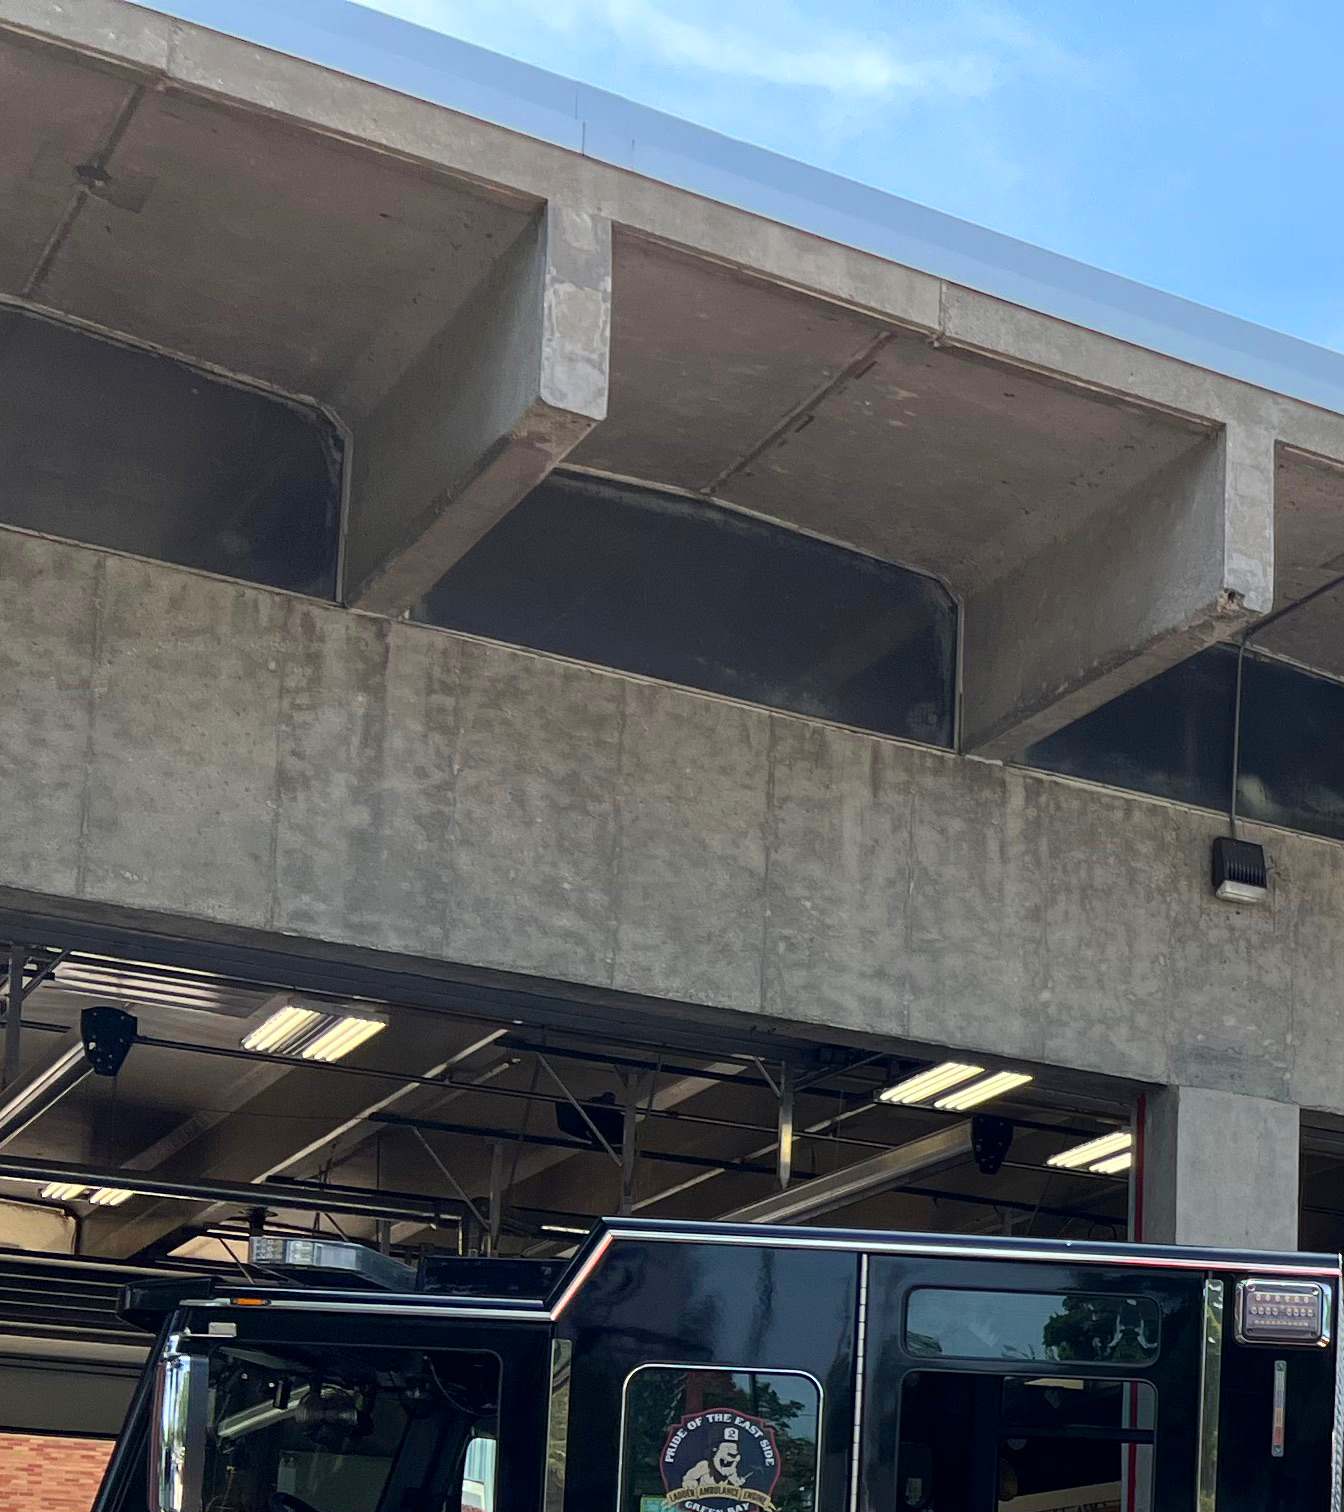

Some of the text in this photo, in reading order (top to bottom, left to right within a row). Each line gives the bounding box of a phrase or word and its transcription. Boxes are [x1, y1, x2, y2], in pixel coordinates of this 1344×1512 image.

[664, 1413, 776, 1467] PRIDE OF THE EAST SIDE
